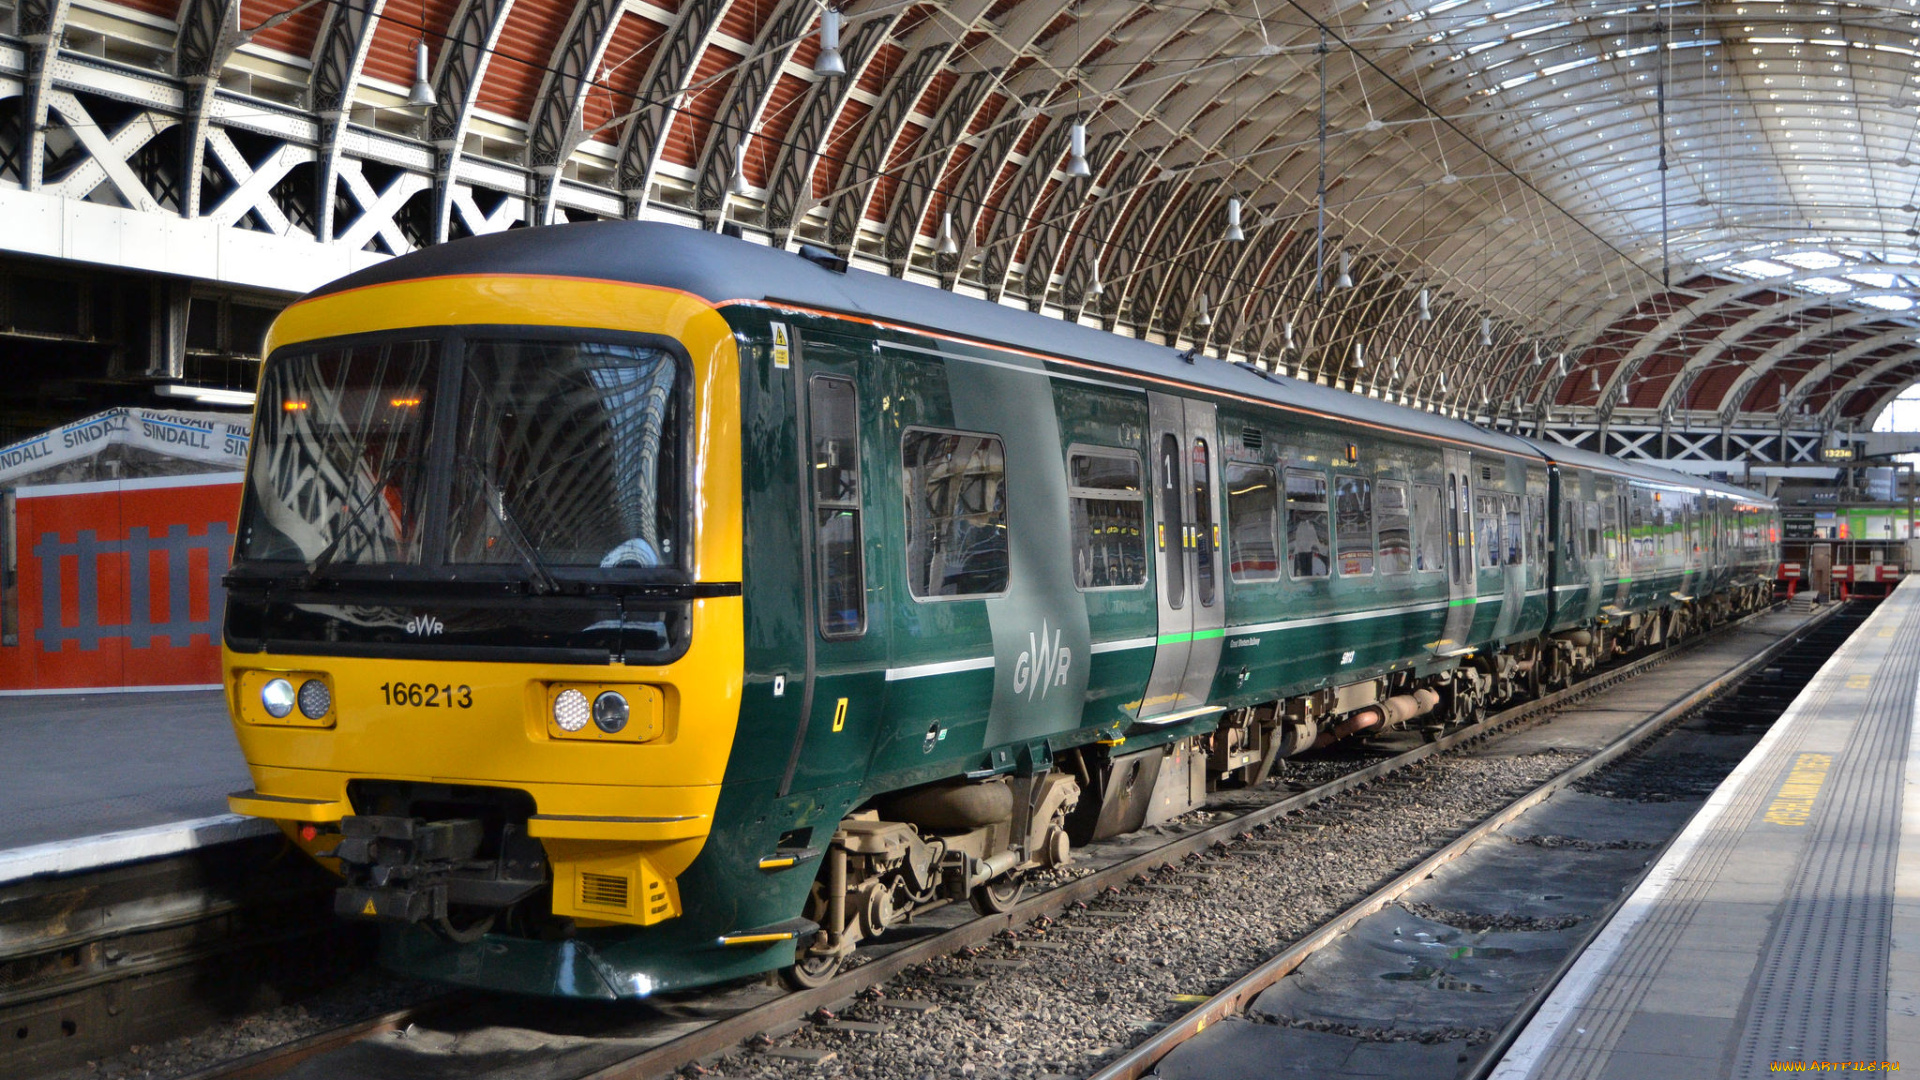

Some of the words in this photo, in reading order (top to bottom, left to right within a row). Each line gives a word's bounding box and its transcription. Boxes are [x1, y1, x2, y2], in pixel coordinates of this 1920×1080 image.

[64, 416, 129, 449] SINDALL
[143, 422, 210, 450] SINDALL
[0, 441, 53, 471] NDALL
[1164, 453, 1173, 490] 1
[406, 613, 444, 637] GWR
[1013, 617, 1072, 703] GWR
[380, 681, 473, 709] 166213
